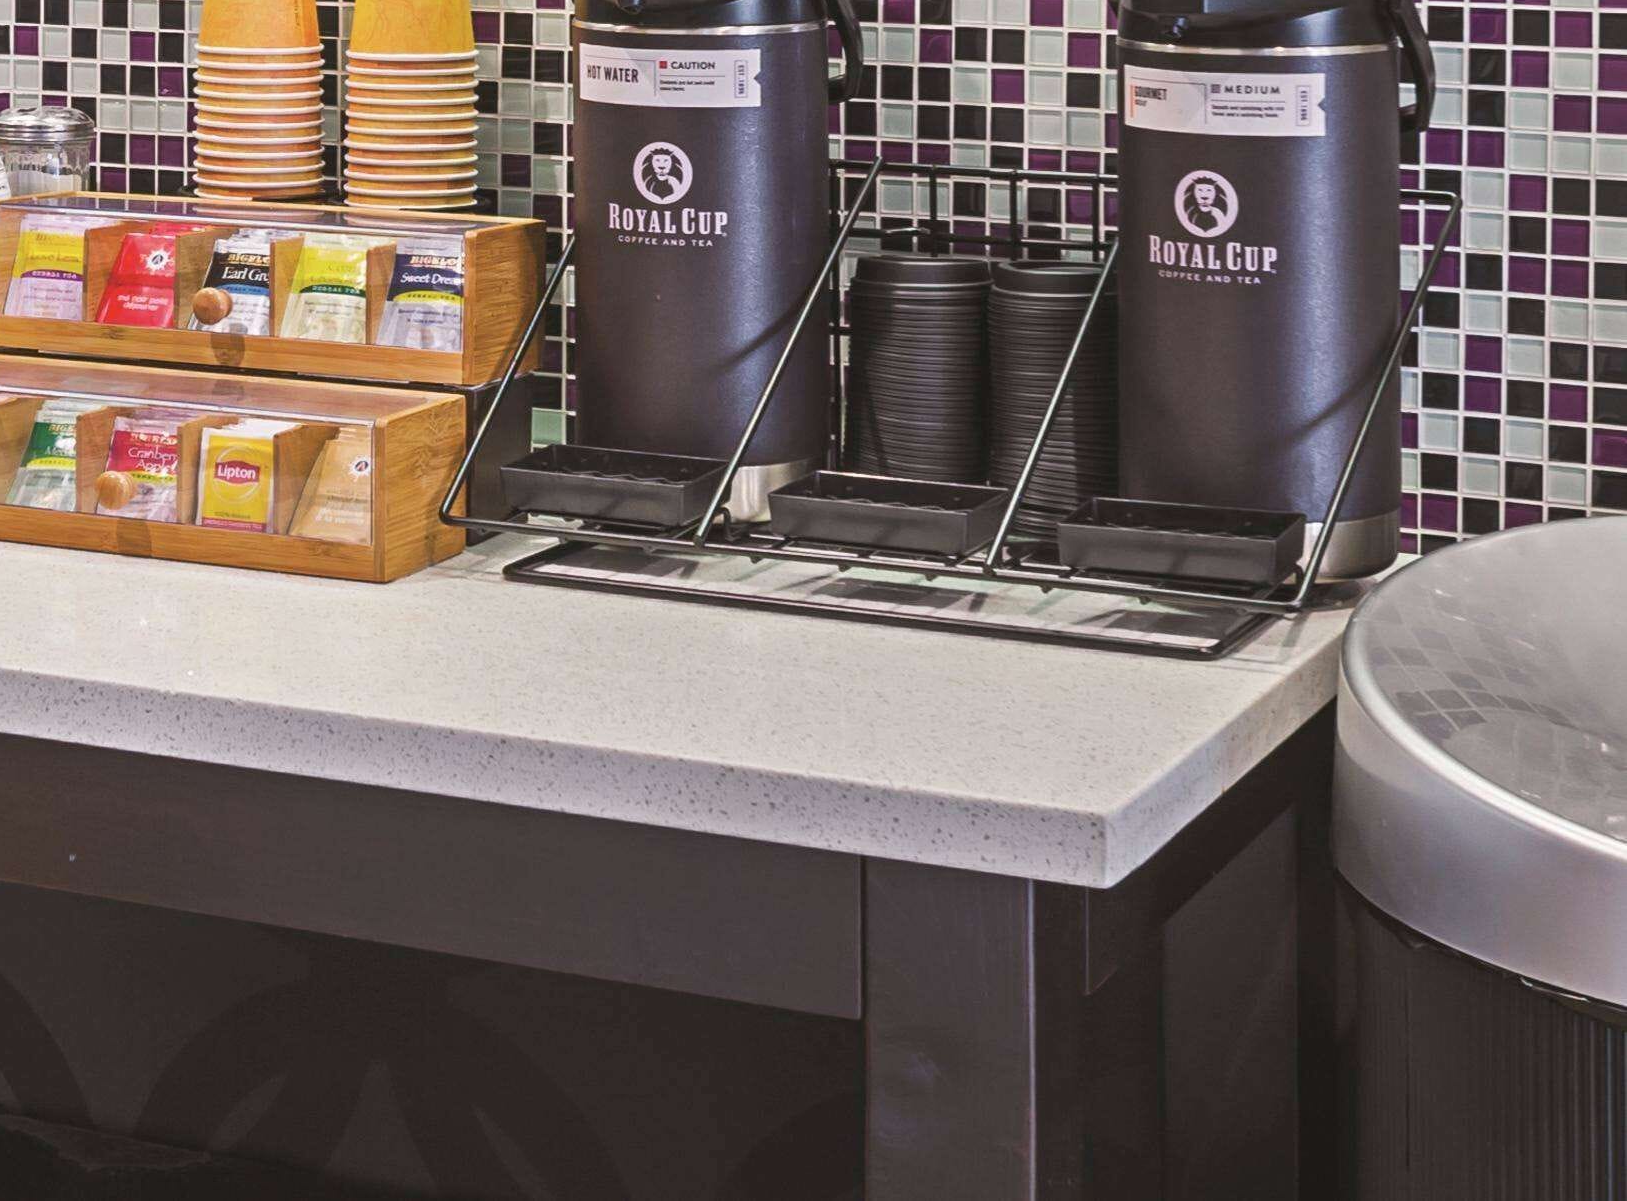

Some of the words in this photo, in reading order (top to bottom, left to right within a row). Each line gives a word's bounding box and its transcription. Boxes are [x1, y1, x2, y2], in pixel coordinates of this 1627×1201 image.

[670, 61, 716, 70] CAUTION
[586, 64, 602, 79] HOT
[604, 65, 639, 83] WATER
[1224, 85, 1281, 94] MEDIUM
[608, 202, 677, 234] ROYAL
[681, 207, 728, 235] CUP
[618, 235, 658, 245] COFFEE
[691, 239, 713, 247] TEA
[1149, 234, 1221, 270] ROYAL
[1226, 241, 1278, 272] CUP
[222, 266, 248, 280] Earl
[400, 272, 431, 284] Sweet
[1158, 270, 1202, 281] COFFEE
[1205, 275, 1232, 284] AND
[1236, 276, 1262, 285] TEA
[217, 464, 256, 481] Lipton
